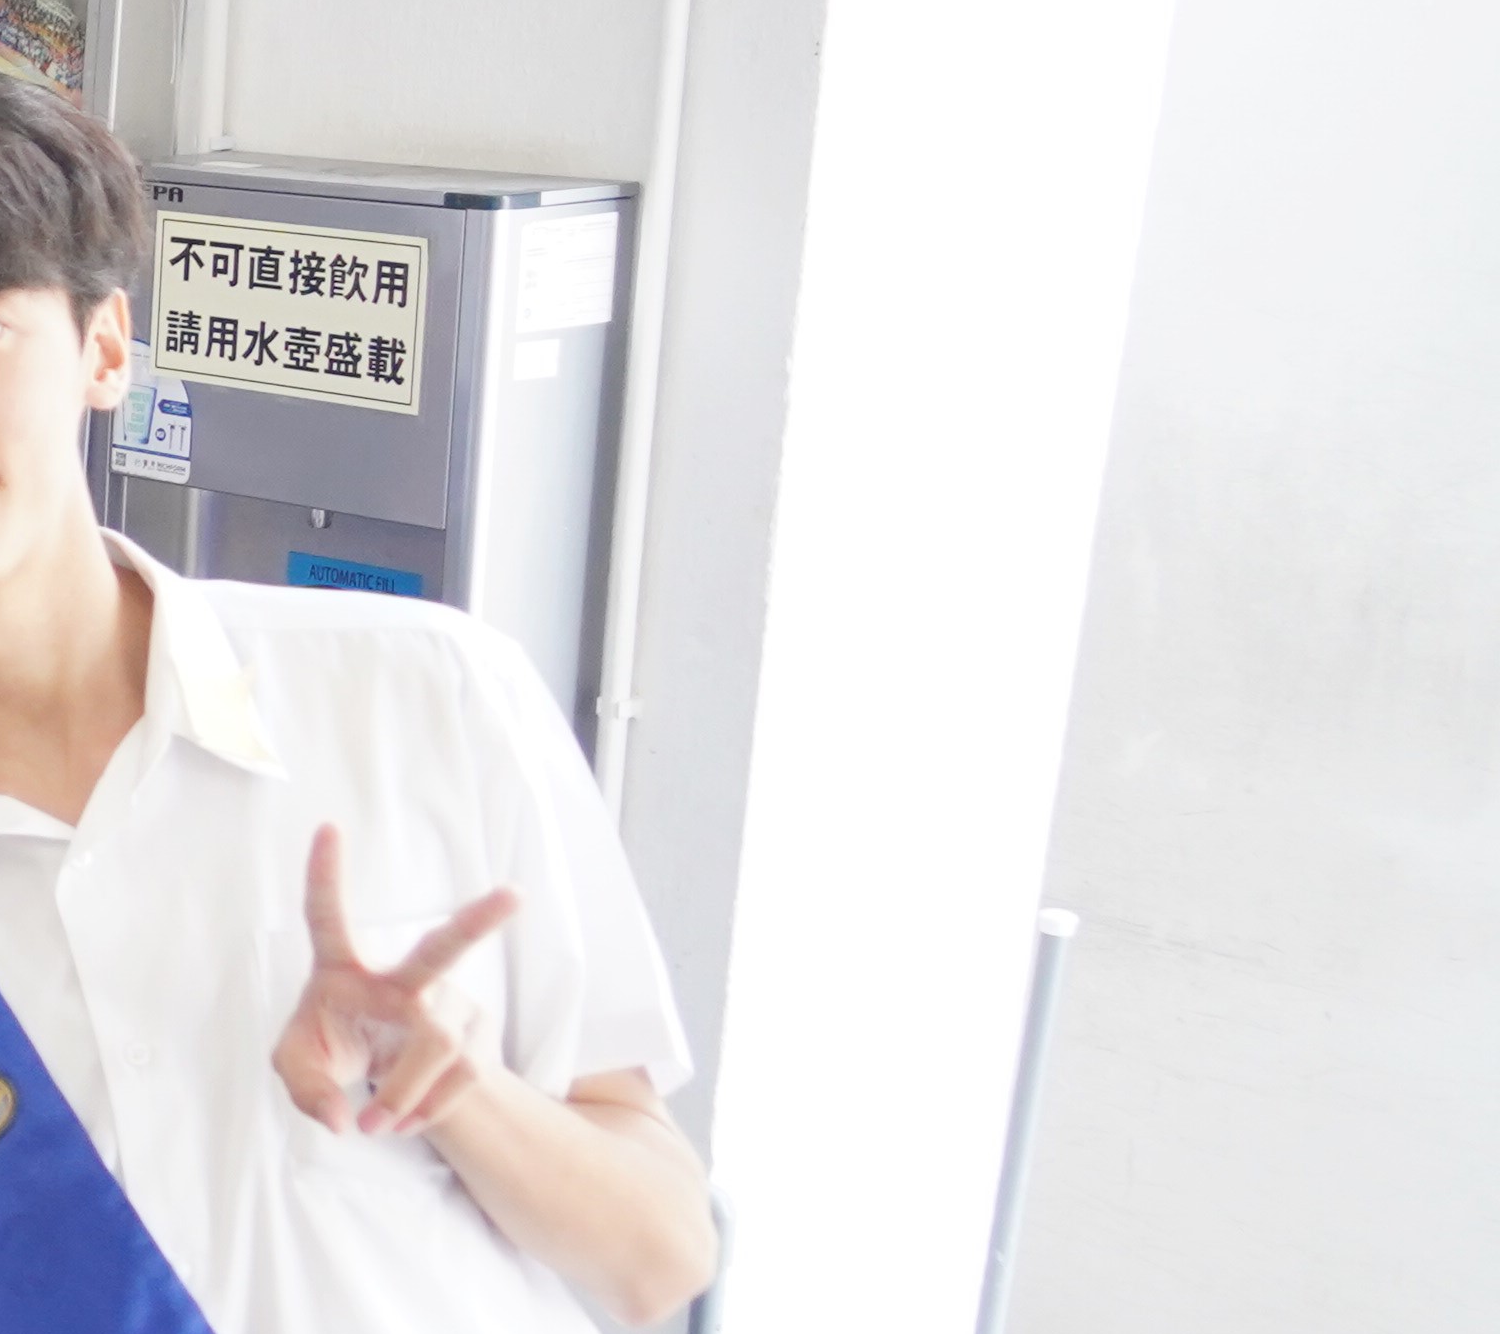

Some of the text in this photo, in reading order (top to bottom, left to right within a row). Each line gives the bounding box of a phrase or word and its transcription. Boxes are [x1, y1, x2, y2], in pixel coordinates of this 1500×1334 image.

[169, 237, 409, 308] 不可直接飲用
[165, 310, 407, 386] 請用水壺盛載
[309, 564, 374, 590] AUTOMATIC
